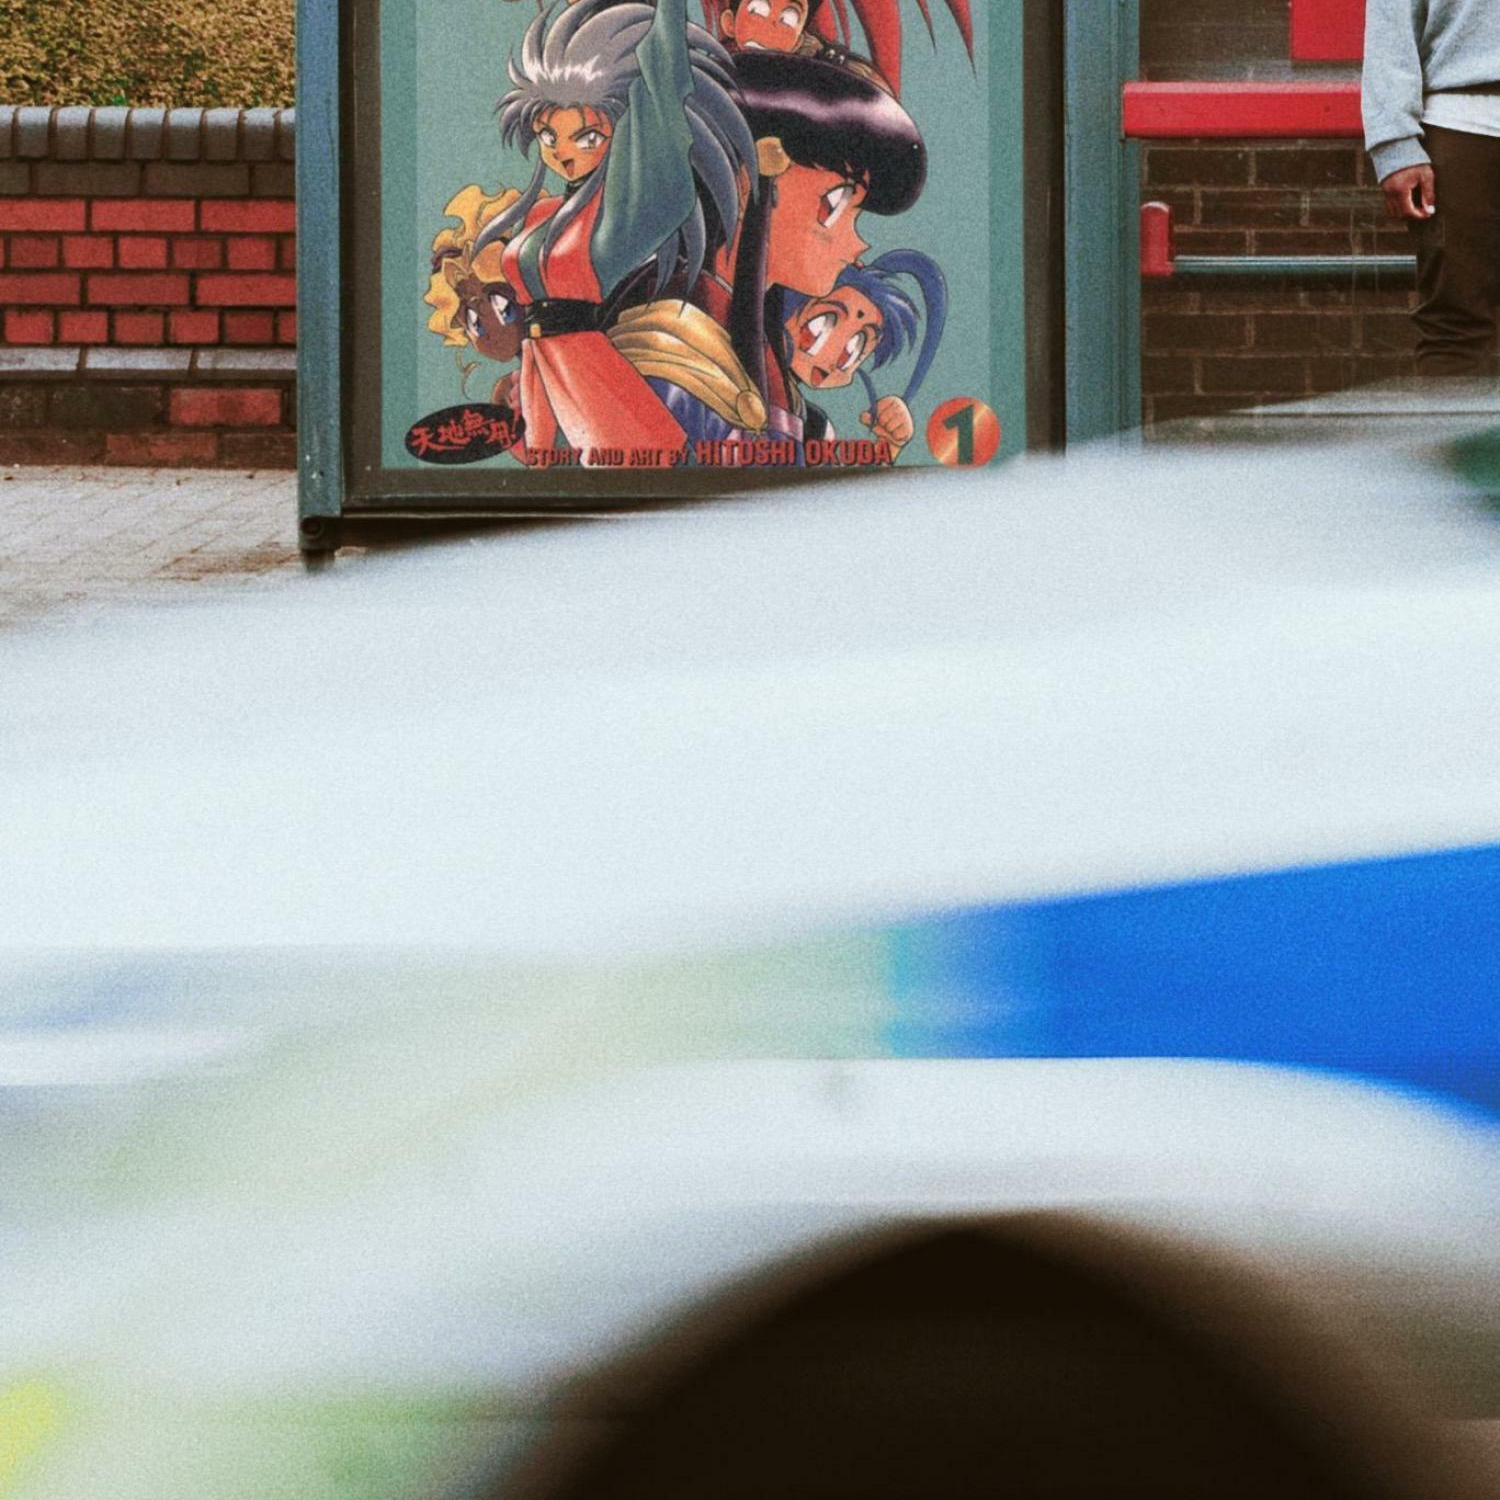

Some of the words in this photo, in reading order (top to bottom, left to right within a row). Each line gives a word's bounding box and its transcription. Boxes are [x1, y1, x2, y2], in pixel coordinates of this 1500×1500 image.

[527, 447, 583, 467] STORY
[588, 447, 625, 467] AND
[629, 447, 664, 467] ART
[668, 447, 691, 467] BY
[695, 438, 796, 467] HITOSHI
[804, 438, 895, 467] OKUDA
[943, 403, 976, 465] 1
